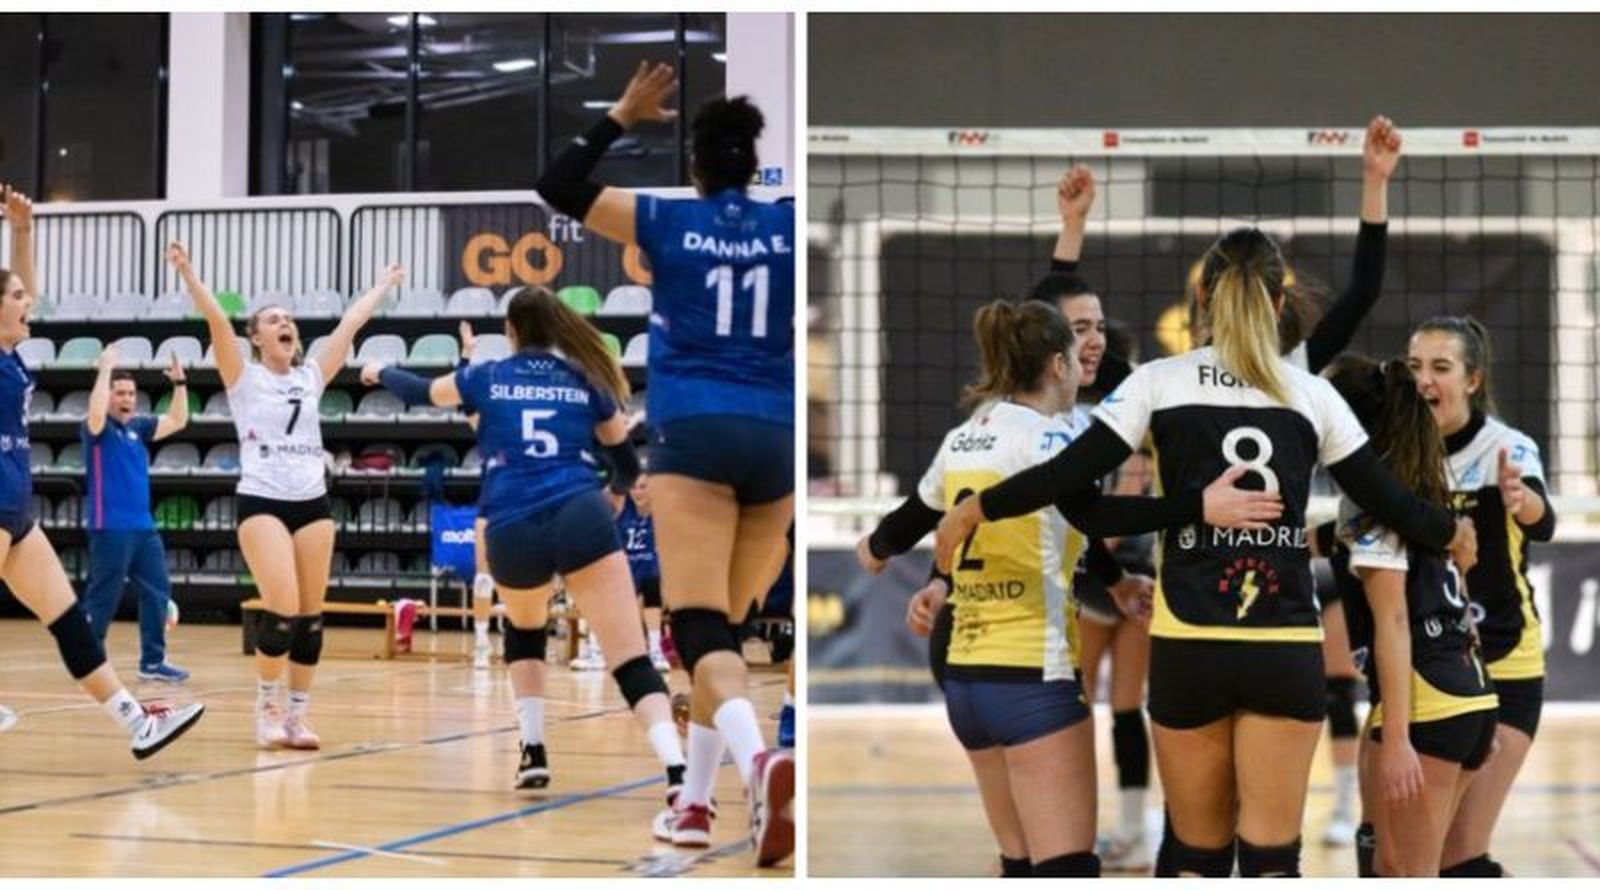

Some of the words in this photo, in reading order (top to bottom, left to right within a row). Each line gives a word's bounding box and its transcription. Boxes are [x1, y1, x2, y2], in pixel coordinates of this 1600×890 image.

[549, 215, 584, 242] fit
[683, 231, 768, 257] DANNA
[771, 235, 791, 253] E.
[462, 233, 563, 285] GO
[706, 265, 769, 336] 11
[490, 384, 590, 404] SILBERSTEIN
[286, 399, 302, 434] 7
[522, 409, 559, 458] 5
[1222, 426, 1280, 495] 8
